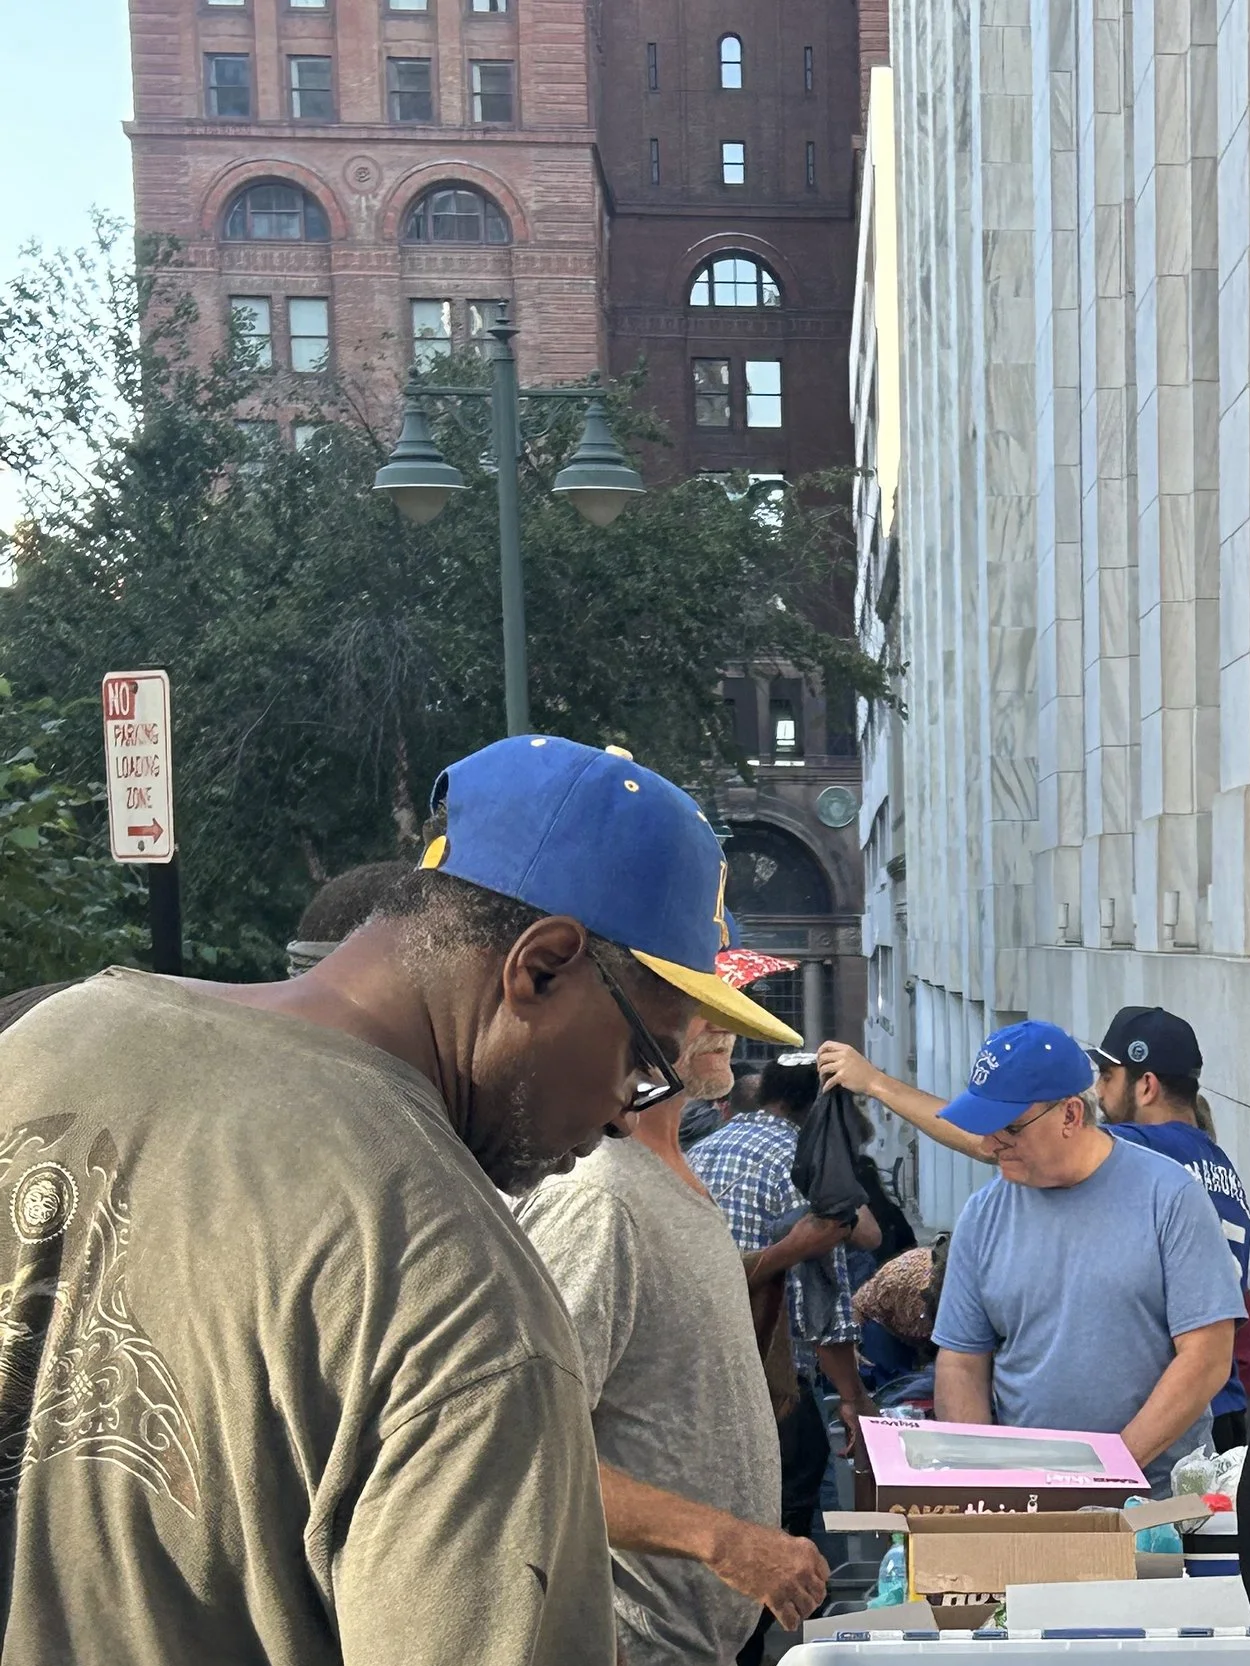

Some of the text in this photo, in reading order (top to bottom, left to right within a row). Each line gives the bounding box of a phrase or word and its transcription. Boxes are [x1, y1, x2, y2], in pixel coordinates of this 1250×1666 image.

[108, 680, 130, 716] NO
[113, 723, 159, 748] PARKING
[115, 754, 160, 778] LOADING
[126, 786, 153, 810] ZONE
